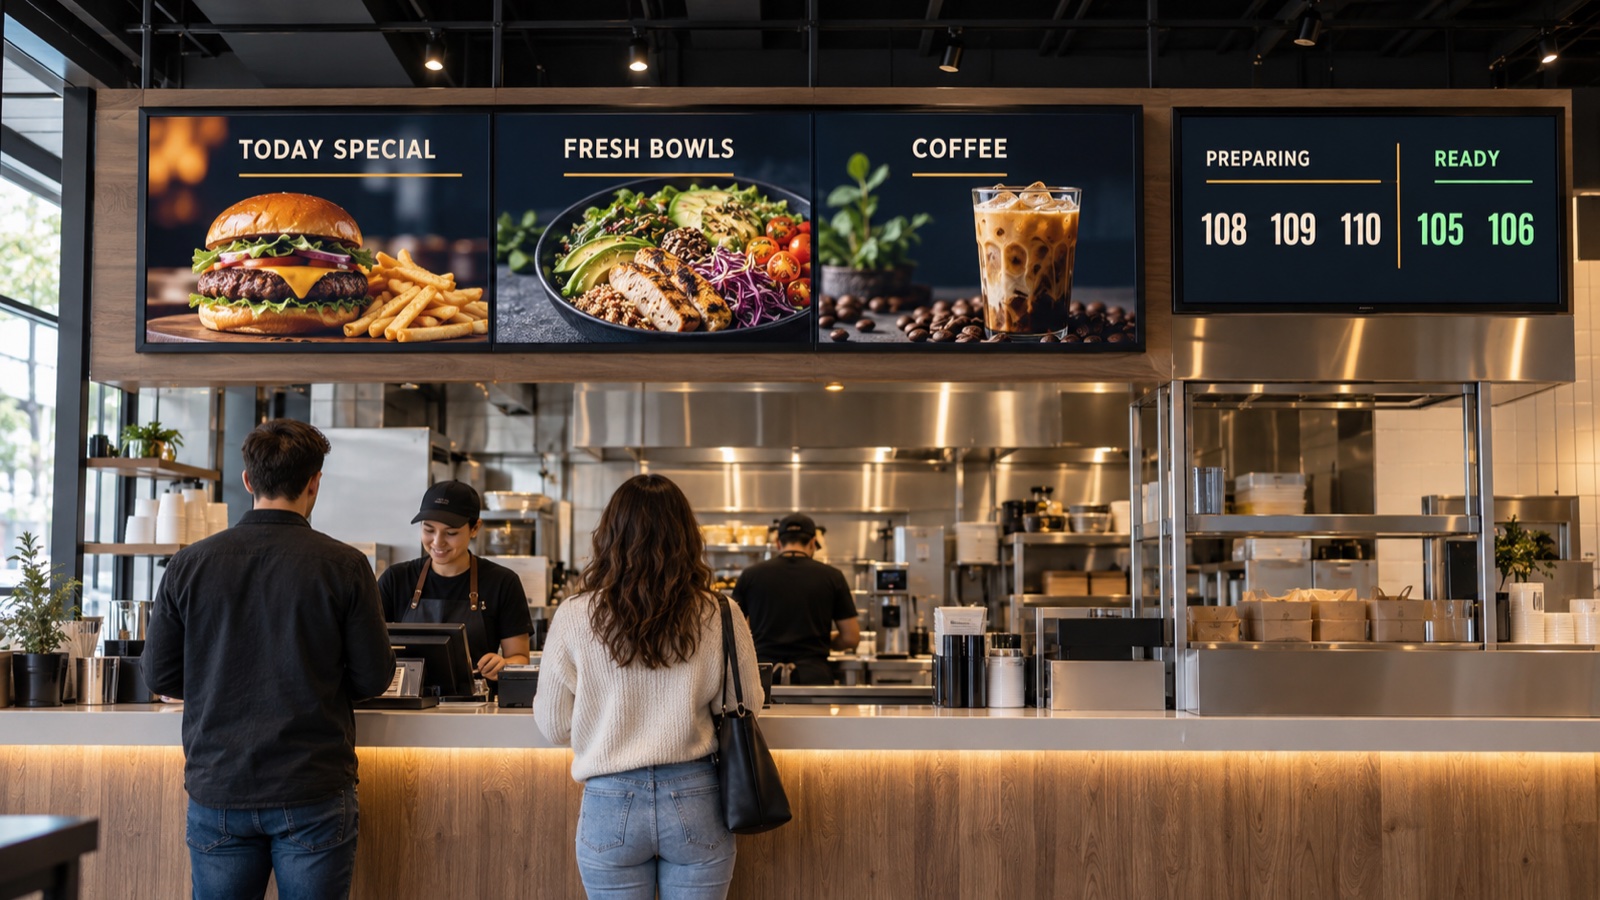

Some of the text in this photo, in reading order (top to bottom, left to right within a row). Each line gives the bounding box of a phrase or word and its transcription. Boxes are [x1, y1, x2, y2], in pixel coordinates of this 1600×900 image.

[239, 139, 436, 160] TODAY SPECIAL
[564, 138, 734, 159] FRESH BOWLS
[912, 138, 1008, 159] COFFEE
[1206, 150, 1310, 167] PREPARING
[1434, 150, 1500, 167] READY
[1201, 212, 1381, 246] 108 109 110
[1418, 212, 1534, 246] 105 106
